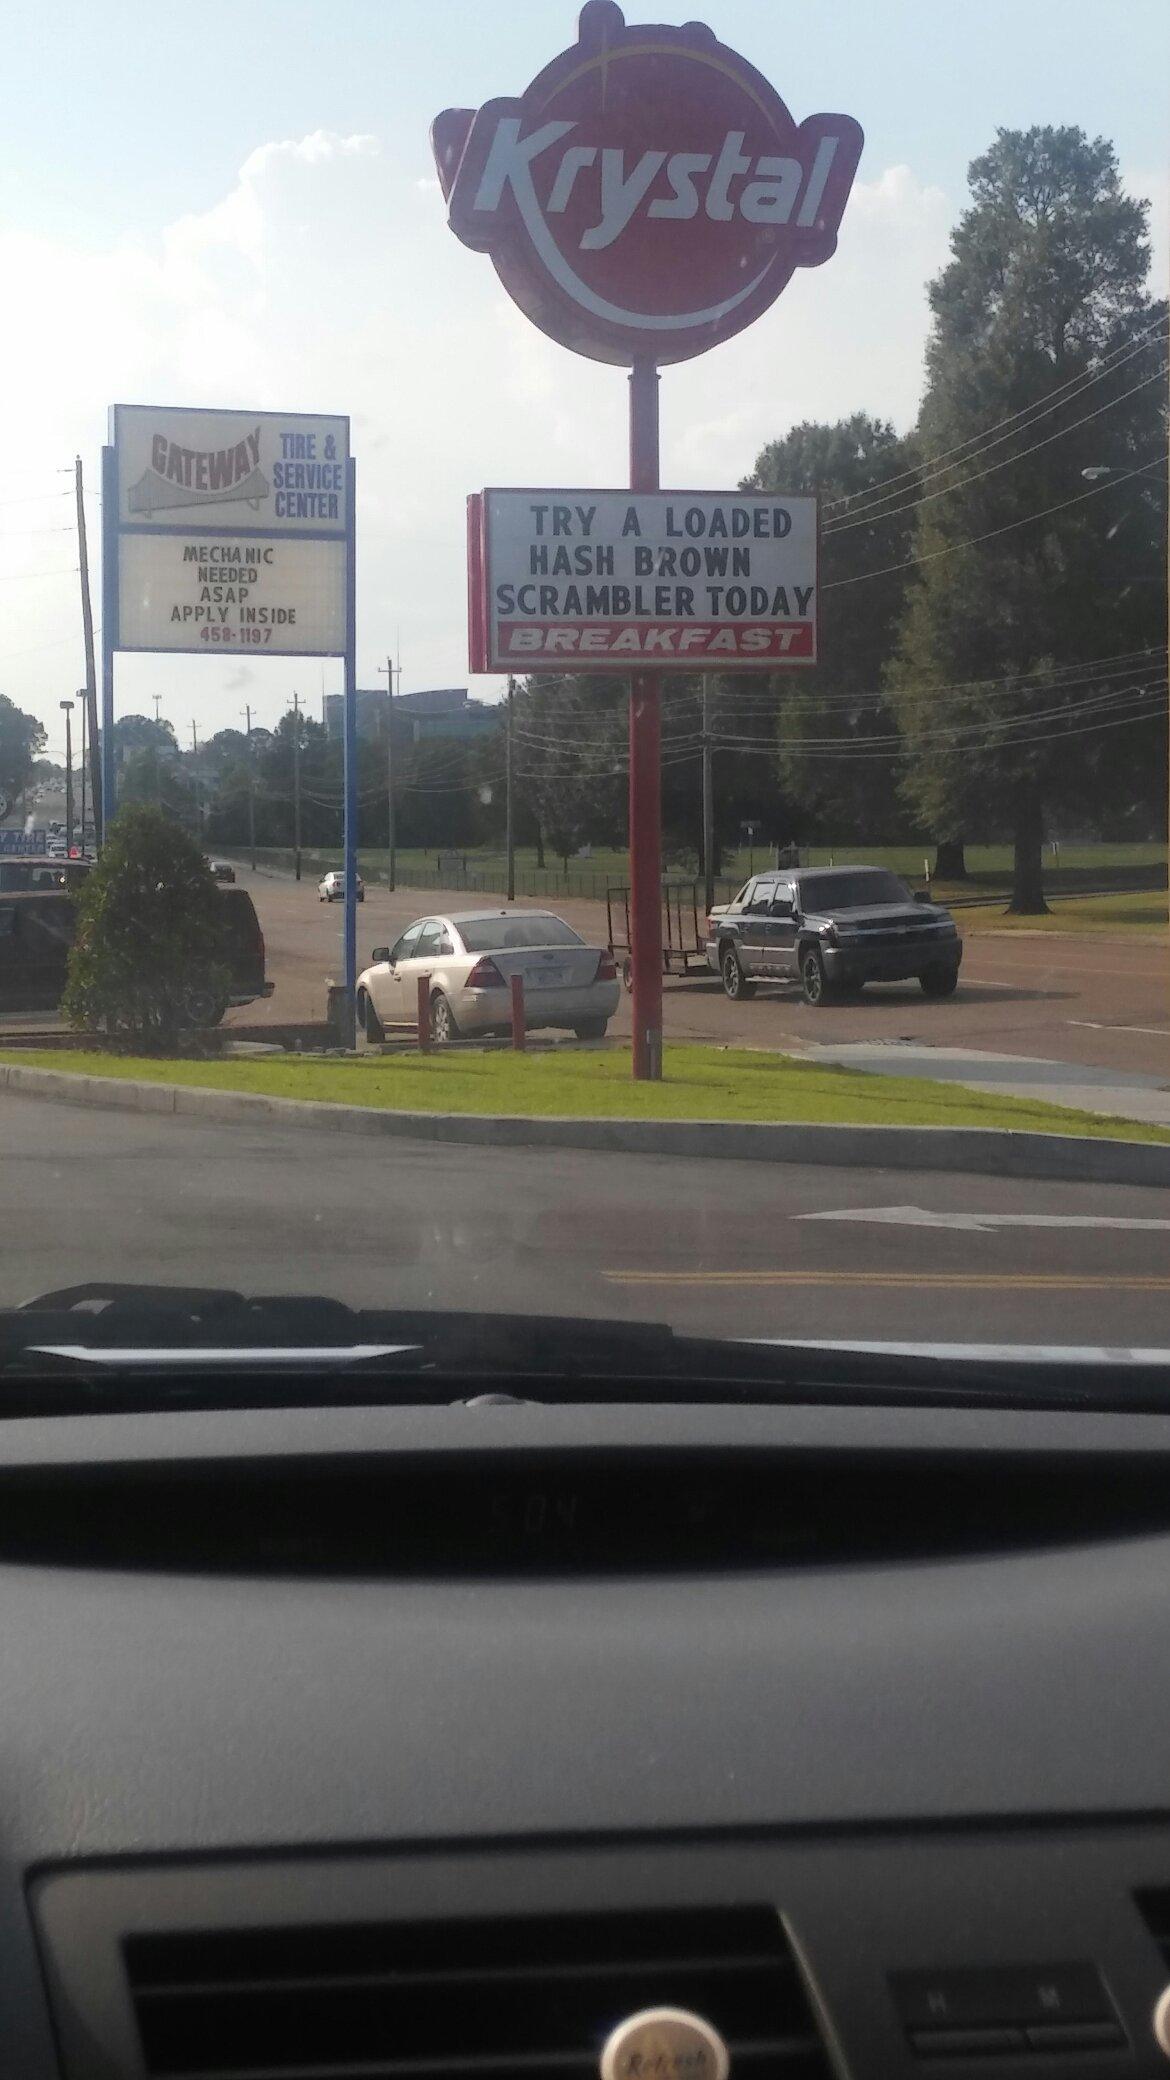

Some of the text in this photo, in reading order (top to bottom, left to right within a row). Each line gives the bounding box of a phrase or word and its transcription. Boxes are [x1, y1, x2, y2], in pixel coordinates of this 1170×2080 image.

[473, 118, 840, 250] Krystal
[152, 425, 261, 490] GATEWAY
[280, 433, 336, 460] TIRE &
[273, 462, 343, 491] SERVICE
[275, 491, 339, 519] CENTER
[530, 505, 792, 538] TRY A LOADED
[183, 546, 274, 564] MECHANIC
[530, 544, 751, 578] HASH BROWN
[198, 567, 258, 584] NEEDED
[200, 586, 249, 604] ASAP
[496, 584, 814, 617] SCRAMBLER TODAY
[171, 606, 296, 625] APPLY INSIDE
[507, 627, 804, 652] BREAKFAST
